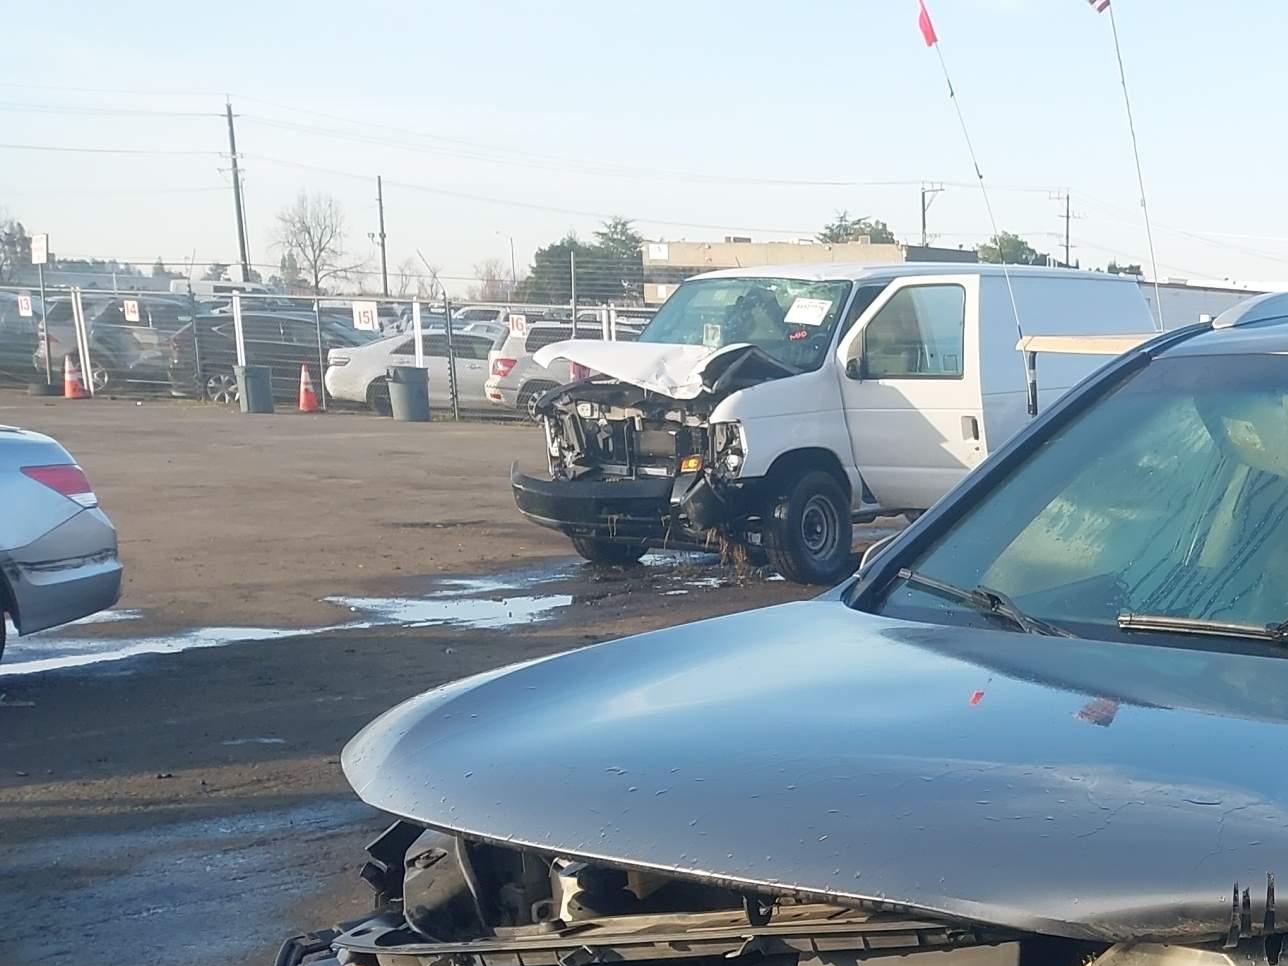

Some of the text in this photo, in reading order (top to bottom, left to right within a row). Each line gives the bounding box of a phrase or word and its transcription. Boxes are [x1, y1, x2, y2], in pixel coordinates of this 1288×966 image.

[20, 297, 30, 311] 13
[126, 303, 137, 315] 14
[511, 317, 524, 331] 16
